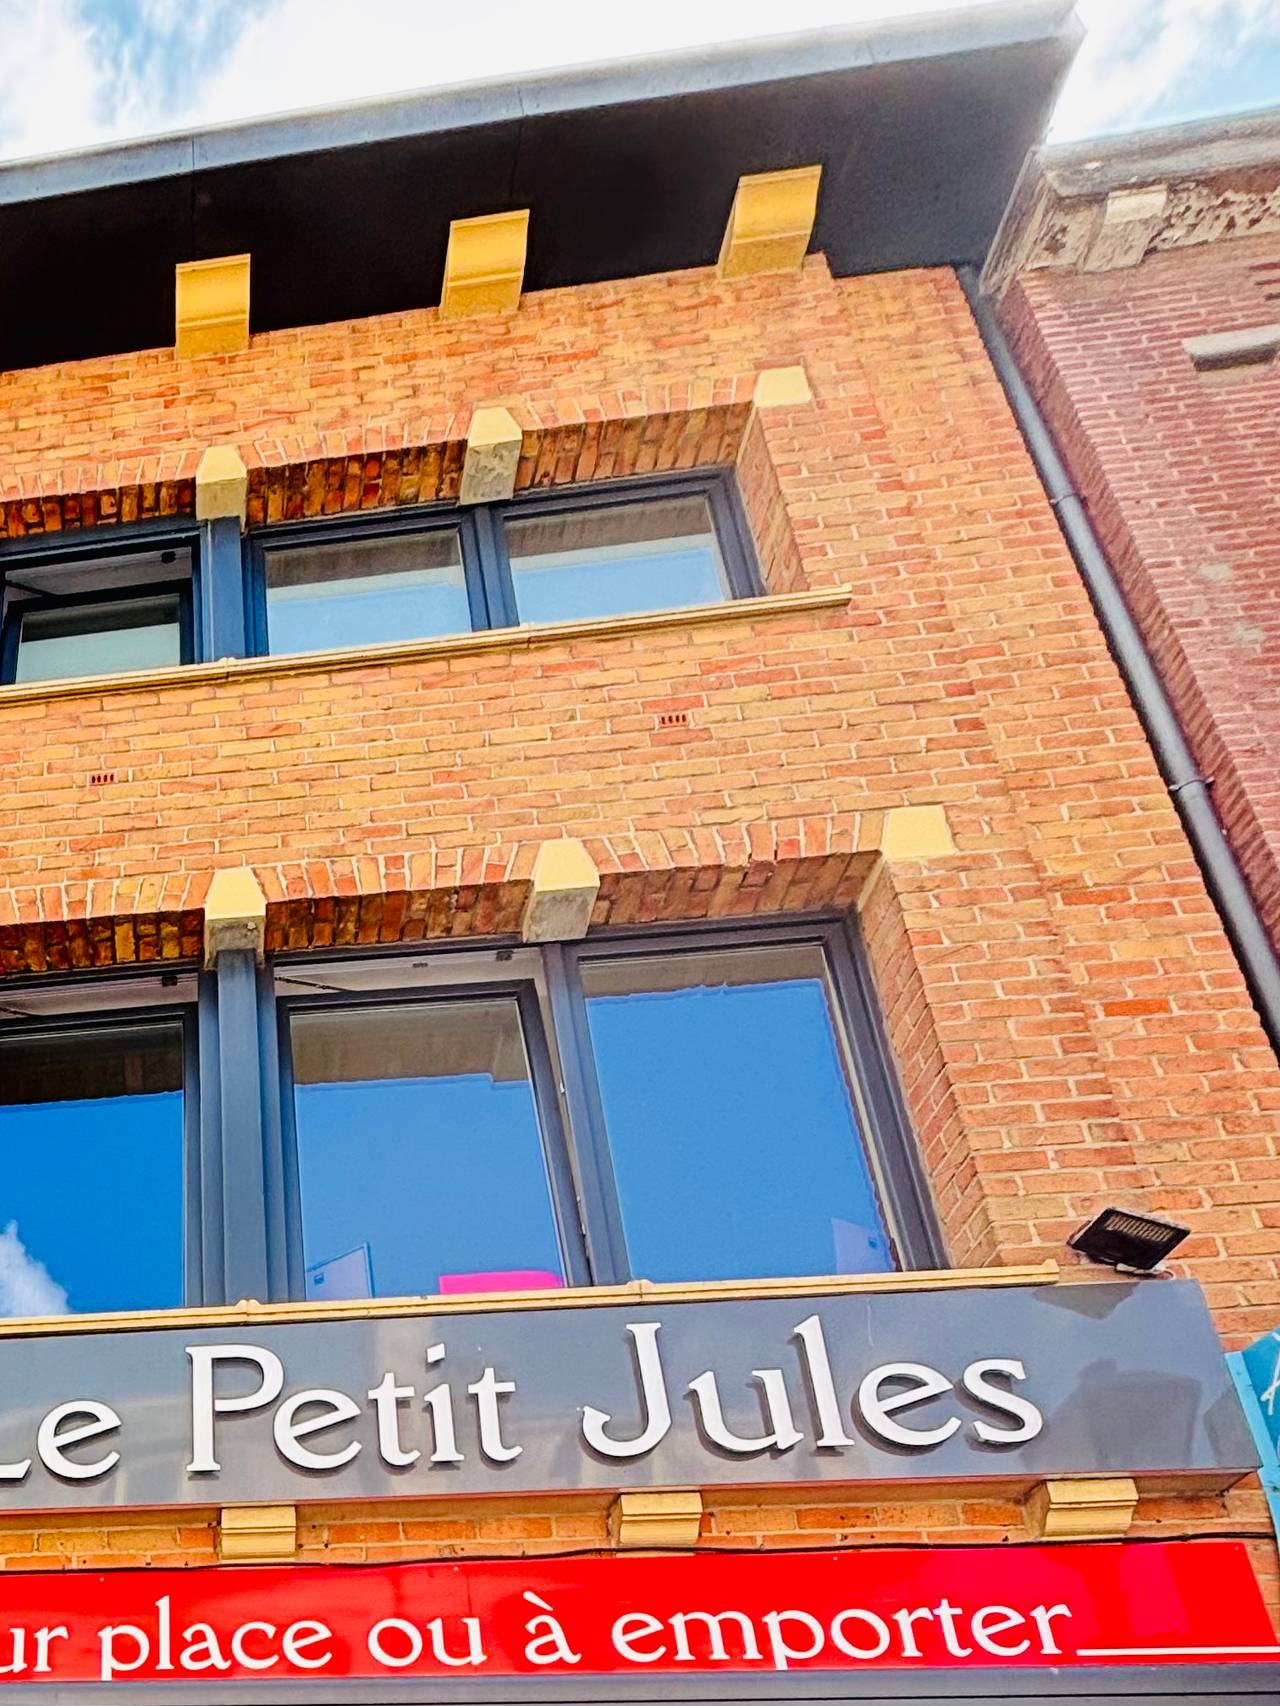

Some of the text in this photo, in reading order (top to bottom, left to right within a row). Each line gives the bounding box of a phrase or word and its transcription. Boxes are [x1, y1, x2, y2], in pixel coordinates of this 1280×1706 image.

[185, 1343, 523, 1472] Petit
[582, 1314, 1043, 1457] Jules
[98, 1595, 334, 1681] place
[367, 1617, 488, 1667] ou
[523, 1590, 582, 1665] à
[612, 1598, 1073, 1670] emporter
